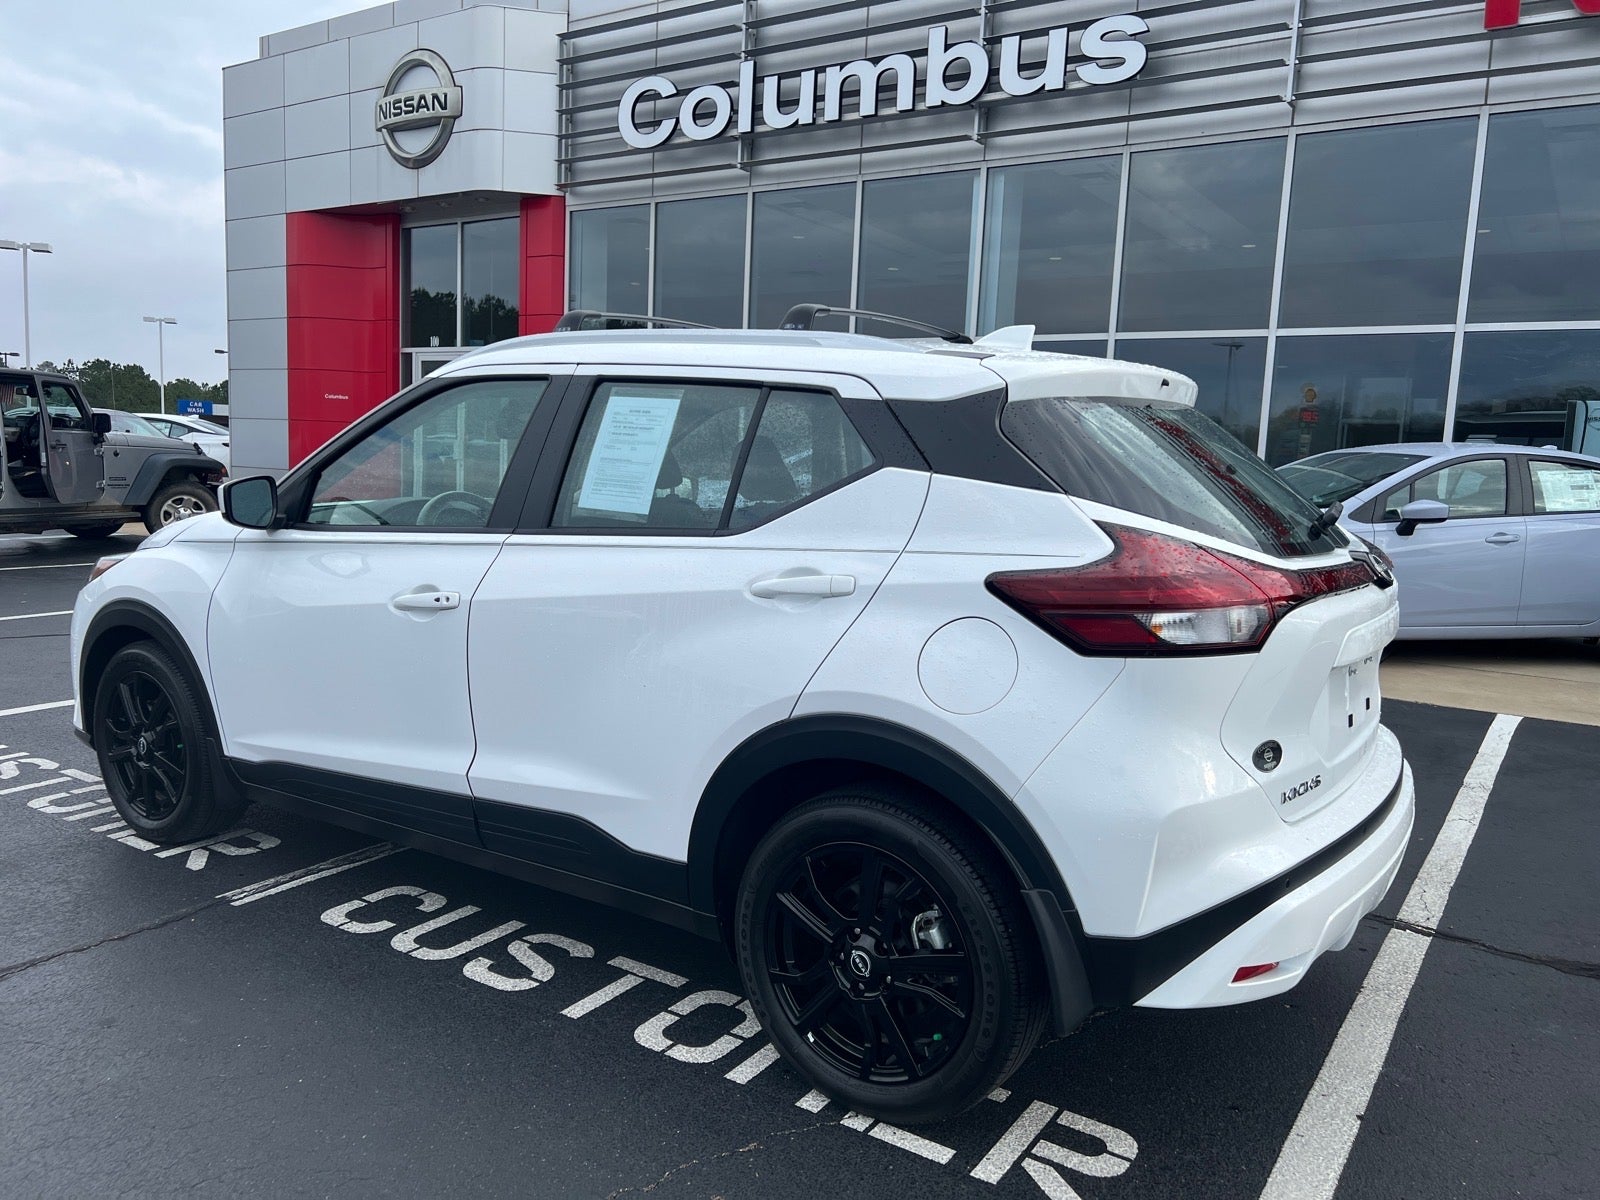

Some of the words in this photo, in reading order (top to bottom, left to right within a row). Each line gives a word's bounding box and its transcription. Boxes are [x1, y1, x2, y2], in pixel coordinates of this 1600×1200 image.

[617, 14, 1150, 149] Columbus
[379, 92, 448, 122] NISSAN
[430, 336, 440, 347] 100
[1280, 775, 1321, 804] KICKS
